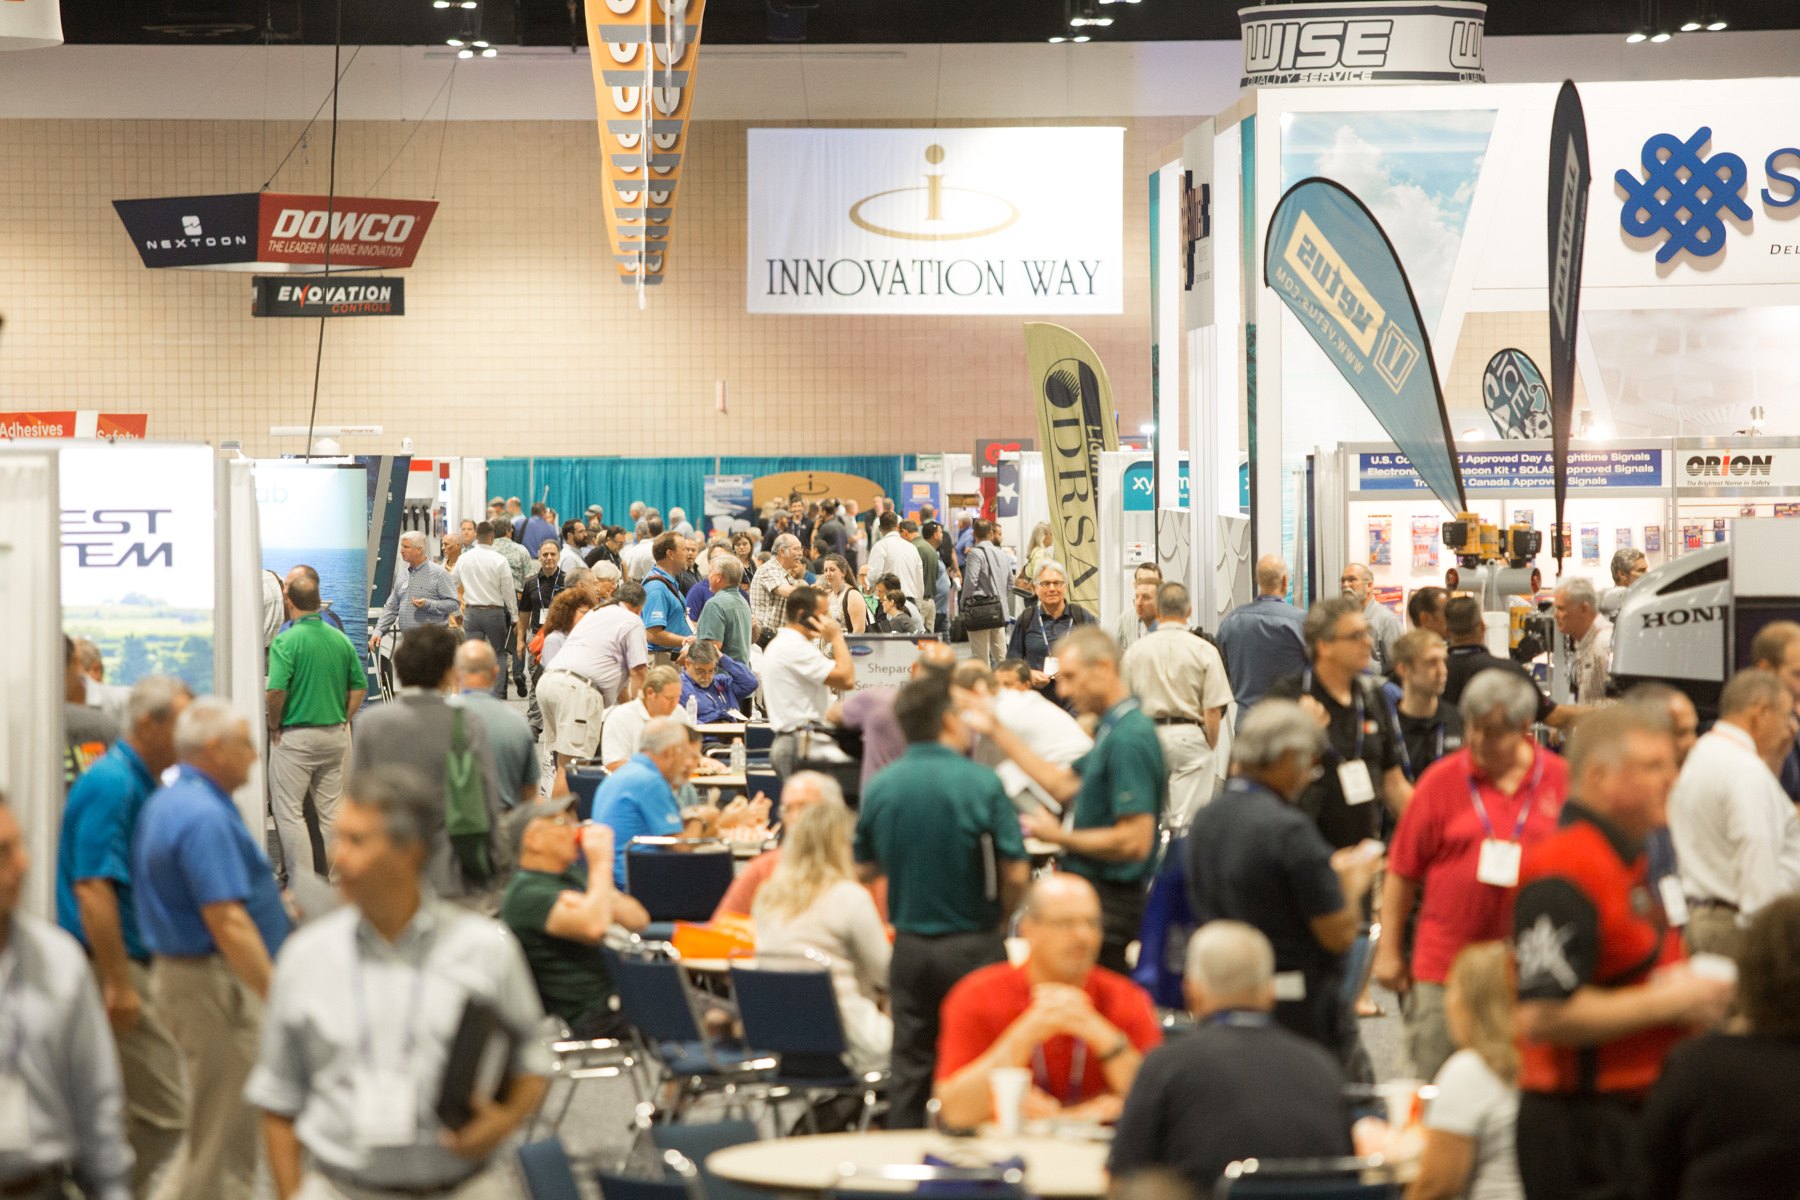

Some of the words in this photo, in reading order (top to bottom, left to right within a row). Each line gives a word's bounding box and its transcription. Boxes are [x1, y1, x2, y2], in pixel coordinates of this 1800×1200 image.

[1246, 19, 1394, 73] WISE
[1247, 74, 1296, 86] QUALITY
[1299, 71, 1372, 83] SERVICE
[271, 209, 416, 243] DOWCO
[146, 236, 247, 249] NEXTOON
[1556, 162, 1577, 315] MAXWELL
[268, 240, 284, 252] THE
[284, 241, 314, 254] LEADER
[315, 244, 325, 254] IN
[356, 245, 404, 257] INNOVATION
[766, 258, 1004, 296] INNOVATION
[1020, 258, 1103, 296] WAY
[278, 285, 392, 303] ENOVATION
[332, 303, 392, 314] CONTROLS
[0, 420, 63, 438] Adhesives
[1370, 455, 1393, 465] U.S.
[1466, 454, 1518, 466] Approved
[1521, 454, 1543, 464] Day
[1545, 454, 1554, 463] &
[1567, 453, 1608, 464] ghttime
[1611, 452, 1651, 463] Signals
[1686, 454, 1773, 477] ORION
[1461, 467, 1492, 475] eacon
[1494, 466, 1509, 474] Kit
[1519, 465, 1555, 475] SOLAS
[1567, 465, 1611, 475] pproved
[1615, 464, 1655, 474] Signals
[1468, 478, 1510, 487] Canada
[1512, 477, 1555, 488] Approve
[1568, 476, 1608, 487] Signals
